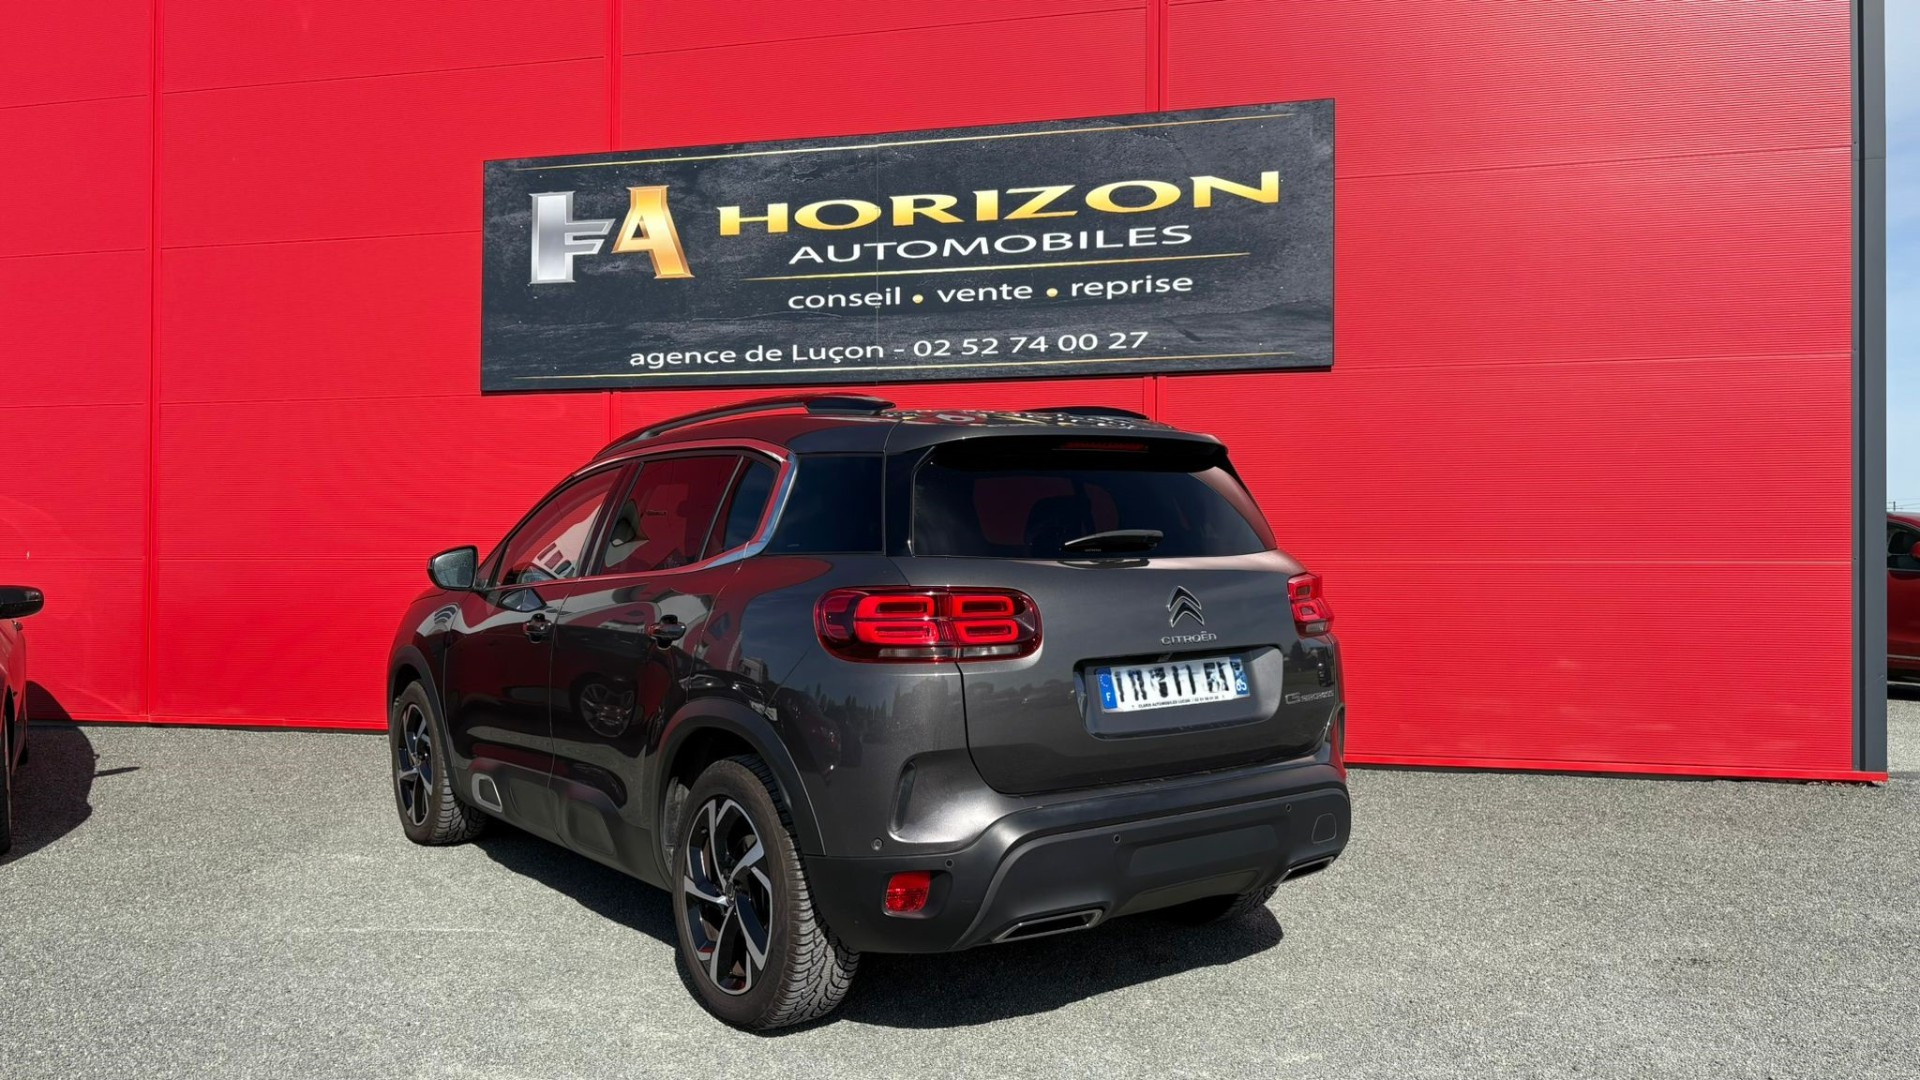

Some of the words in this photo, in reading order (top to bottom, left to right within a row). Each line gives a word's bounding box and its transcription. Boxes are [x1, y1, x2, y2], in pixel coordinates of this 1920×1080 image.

[717, 170, 1280, 236] HORIZON
[788, 224, 1193, 265] AUTOMOBILES
[788, 287, 901, 309] conseil
[937, 283, 1033, 302] vente
[1070, 275, 1194, 300] reprise
[629, 350, 736, 370] agence
[745, 345, 783, 362] de
[792, 344, 884, 365] Luçon
[913, 339, 951, 358] 02
[961, 337, 999, 356] 52
[1010, 335, 1049, 354] 74
[1057, 333, 1099, 352] 00
[1109, 330, 1149, 350] 27
